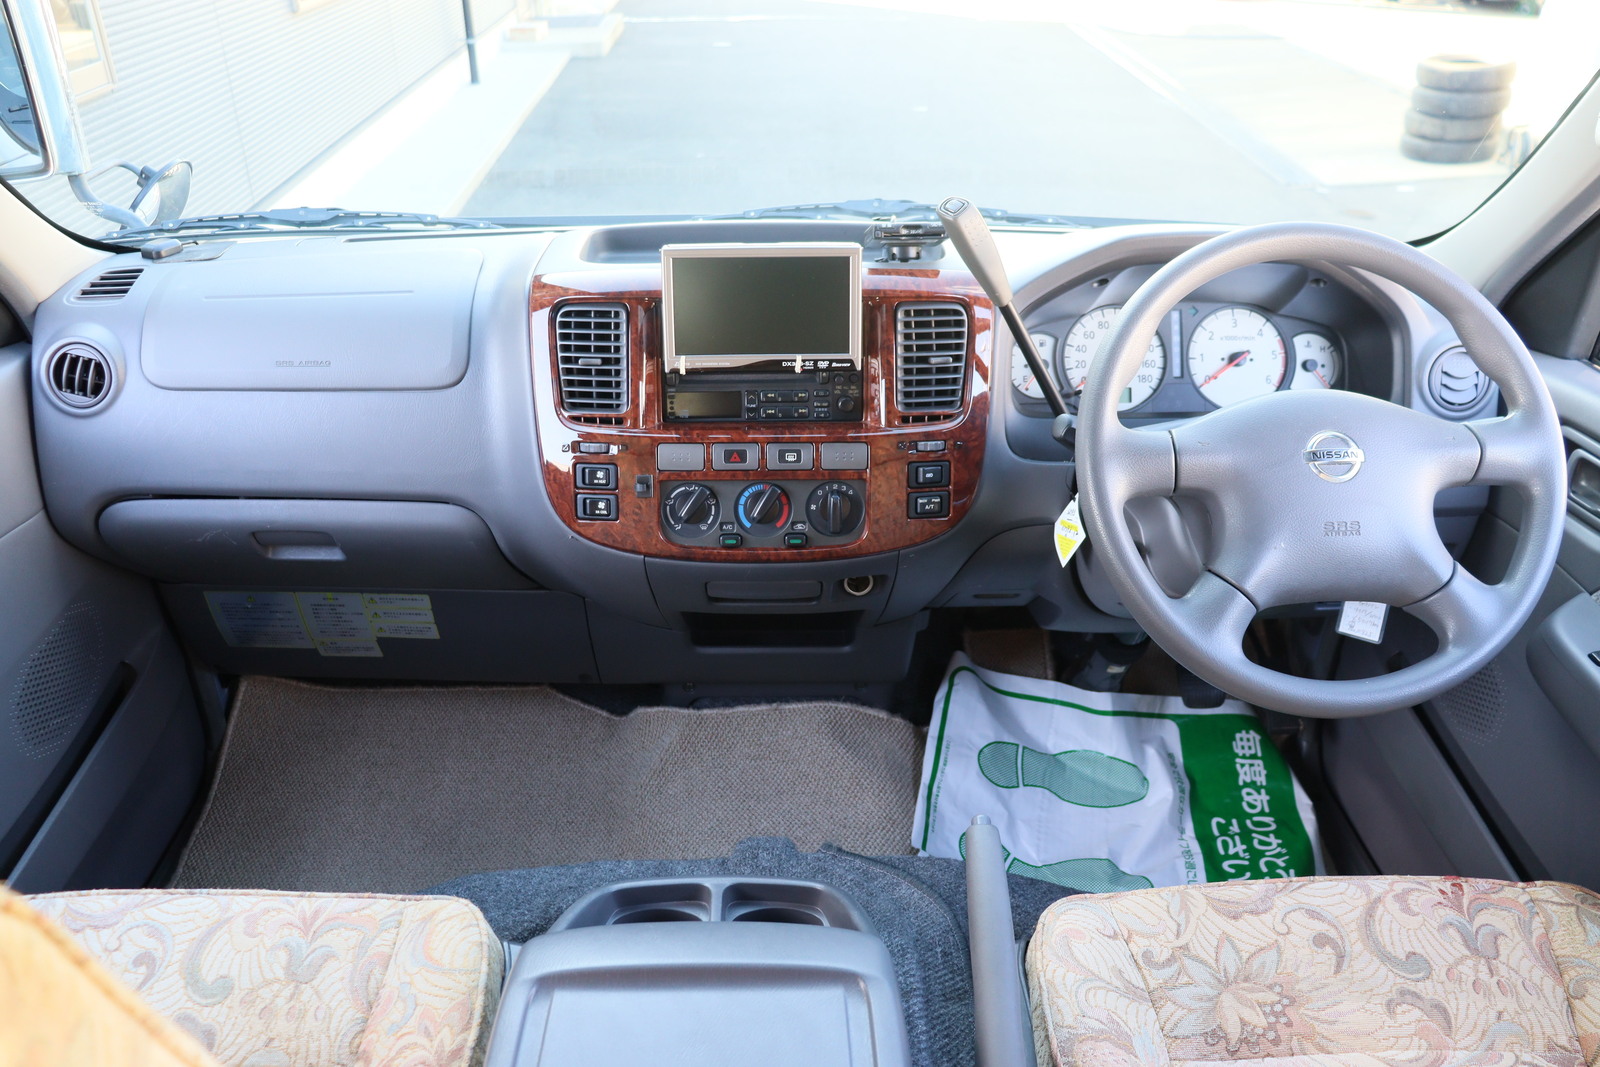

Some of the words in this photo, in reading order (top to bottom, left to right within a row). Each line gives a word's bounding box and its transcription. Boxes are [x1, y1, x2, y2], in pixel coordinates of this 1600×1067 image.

[1097, 321, 1110, 330] 80
[1232, 319, 1238, 328] 3
[1083, 331, 1095, 340] 60
[1208, 331, 1214, 341] 2
[1257, 329, 1264, 337] 4
[1075, 345, 1087, 354] 40
[1271, 351, 1278, 360] 5
[1075, 360, 1087, 369] 20
[1142, 361, 1156, 369] 160
[1137, 375, 1153, 383] 180
[1265, 375, 1272, 384] 6
[1311, 450, 1359, 460] NISSAN
[1323, 520, 1361, 531] SRS
